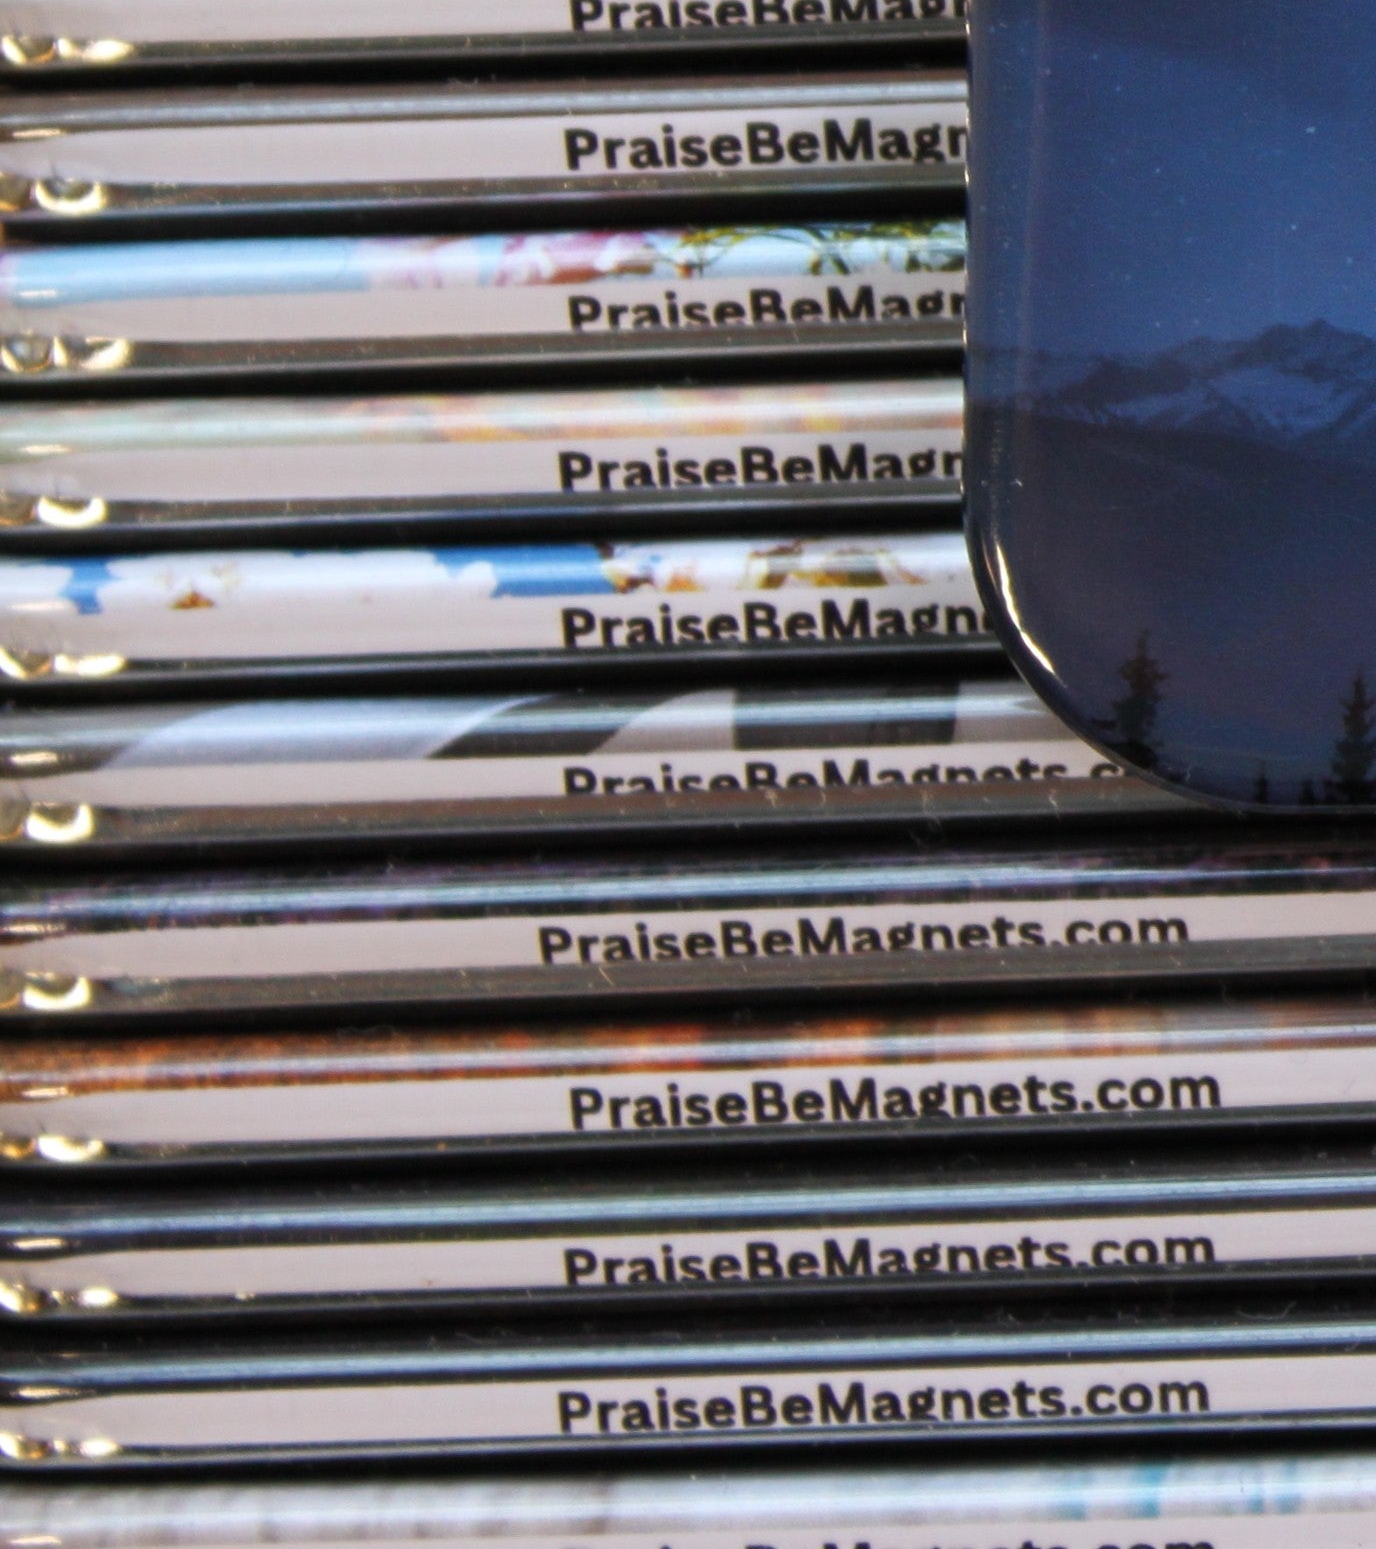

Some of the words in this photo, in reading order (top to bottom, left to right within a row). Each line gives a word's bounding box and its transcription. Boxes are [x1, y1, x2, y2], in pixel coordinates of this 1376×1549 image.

[564, 117, 968, 171] PraiseBeMagn
[568, 285, 966, 332] PraiseBeMag
[557, 444, 966, 494] PraiseBeMagn
[561, 595, 995, 650] PraiseBeMagn
[538, 913, 1190, 966] PraiseBeMagnets.com
[569, 1070, 1221, 1131] PraiseBeMagnets.com
[563, 1228, 1216, 1286] PraiseBeMagnets.com
[557, 1376, 1210, 1434] PraiseBeMagnets.com
